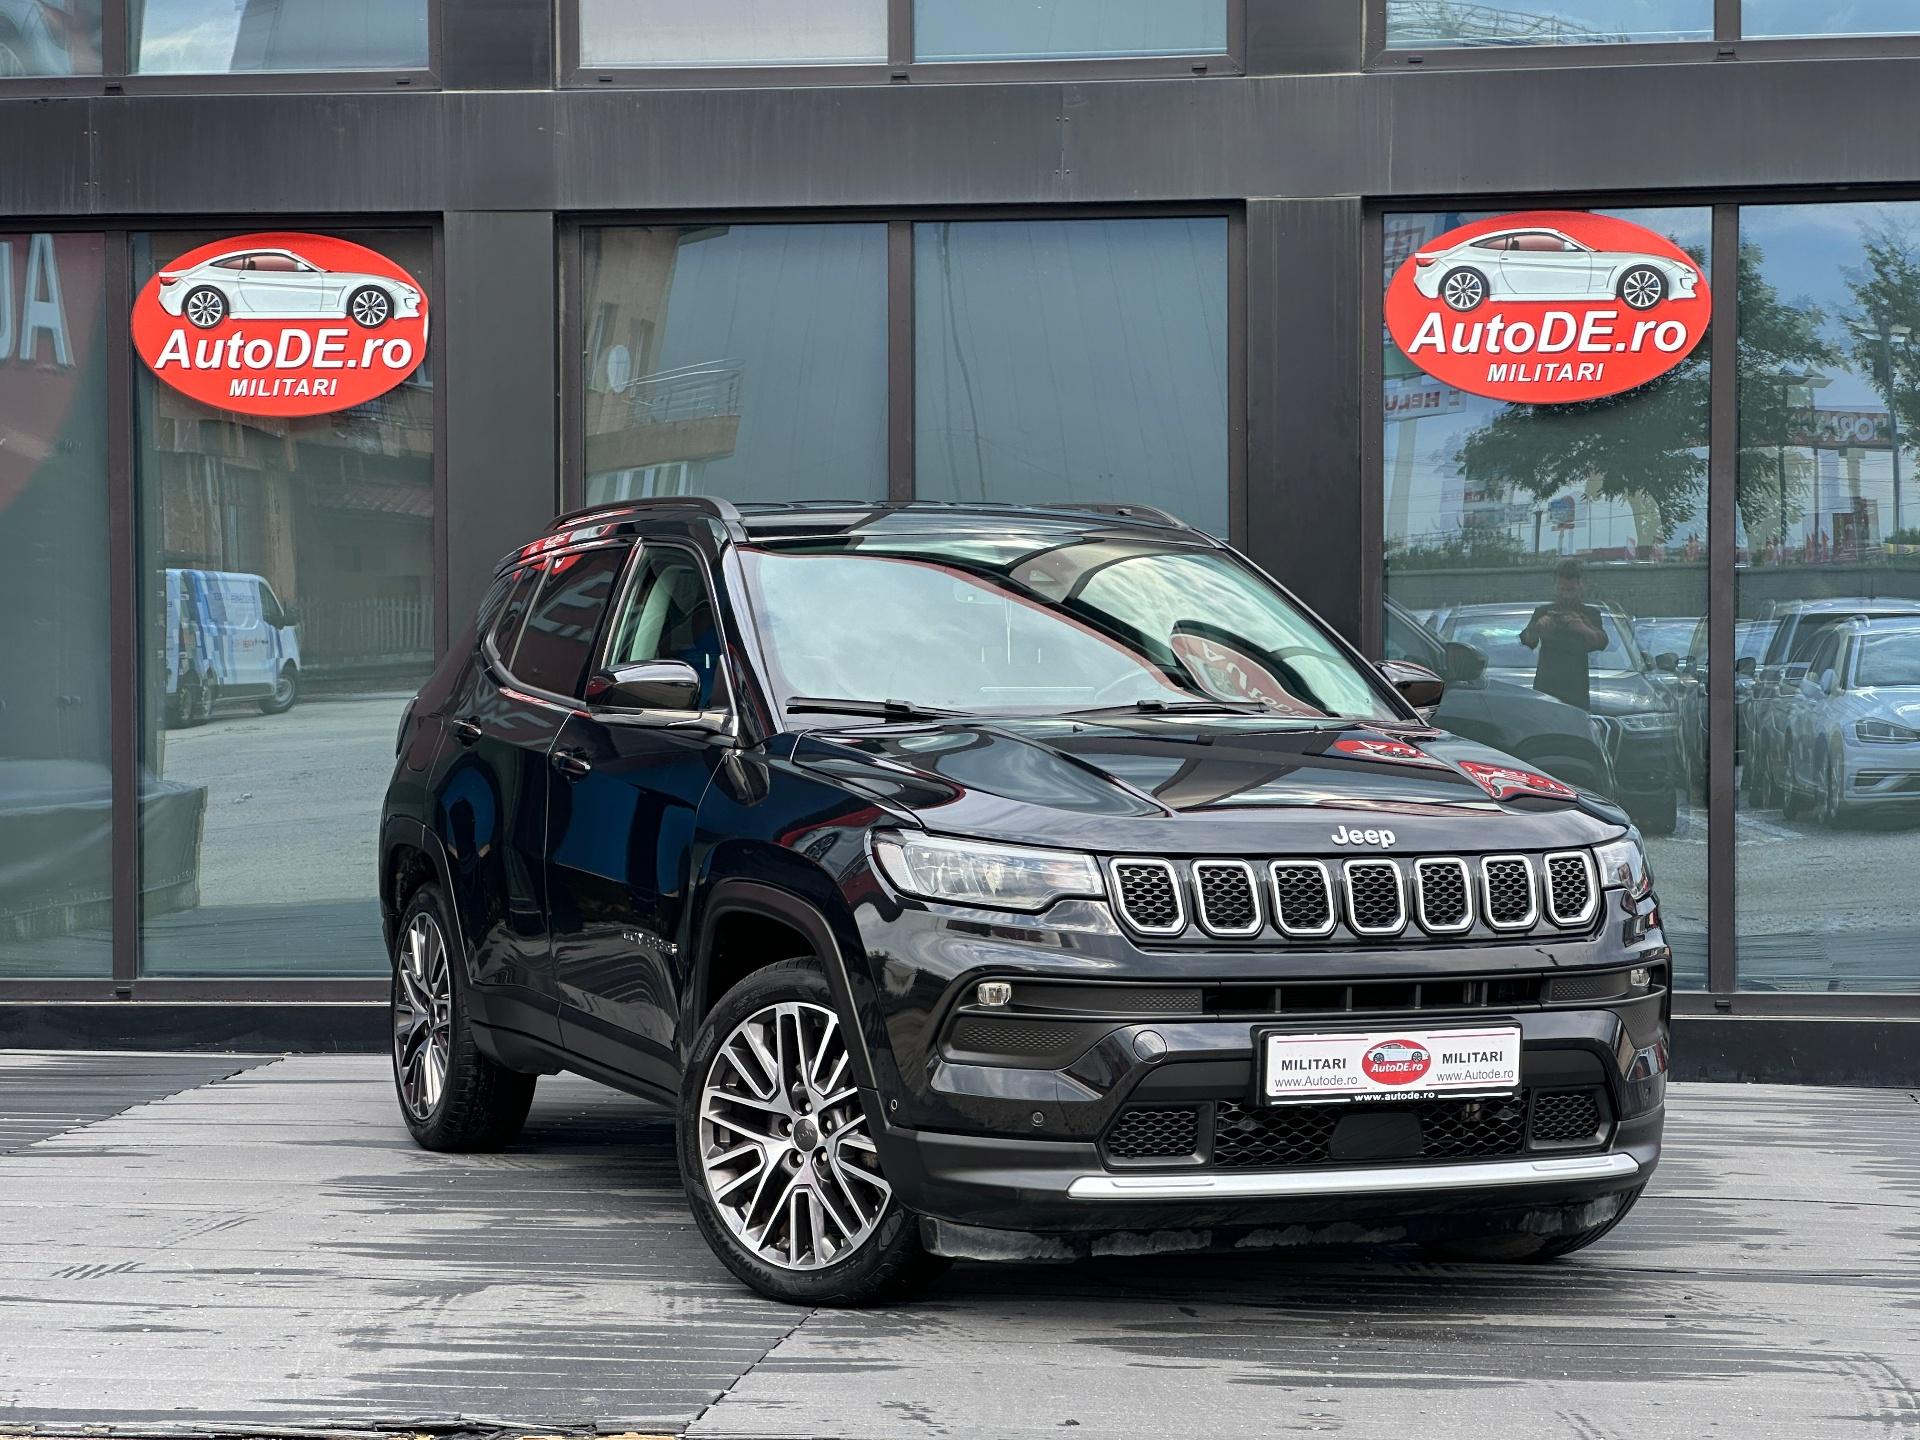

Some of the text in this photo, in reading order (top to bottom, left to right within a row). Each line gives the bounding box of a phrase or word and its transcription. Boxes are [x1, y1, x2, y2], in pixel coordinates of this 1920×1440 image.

[1407, 311, 1688, 354] AutoDE.ro
[153, 329, 413, 370] AutoDE.ro
[1486, 362, 1606, 383] MILITARI
[229, 378, 337, 397] MILITARI
[1331, 826, 1396, 849] Jeep
[1281, 1058, 1347, 1071] MILITARI
[1441, 1051, 1503, 1065] MILITARI
[1371, 1062, 1424, 1074] AutoDE.ro
[1436, 1068, 1514, 1082] www.Autode.ro
[1274, 1075, 1358, 1088] www.Autode.ro
[1354, 1090, 1436, 1102] www.autode.ro
